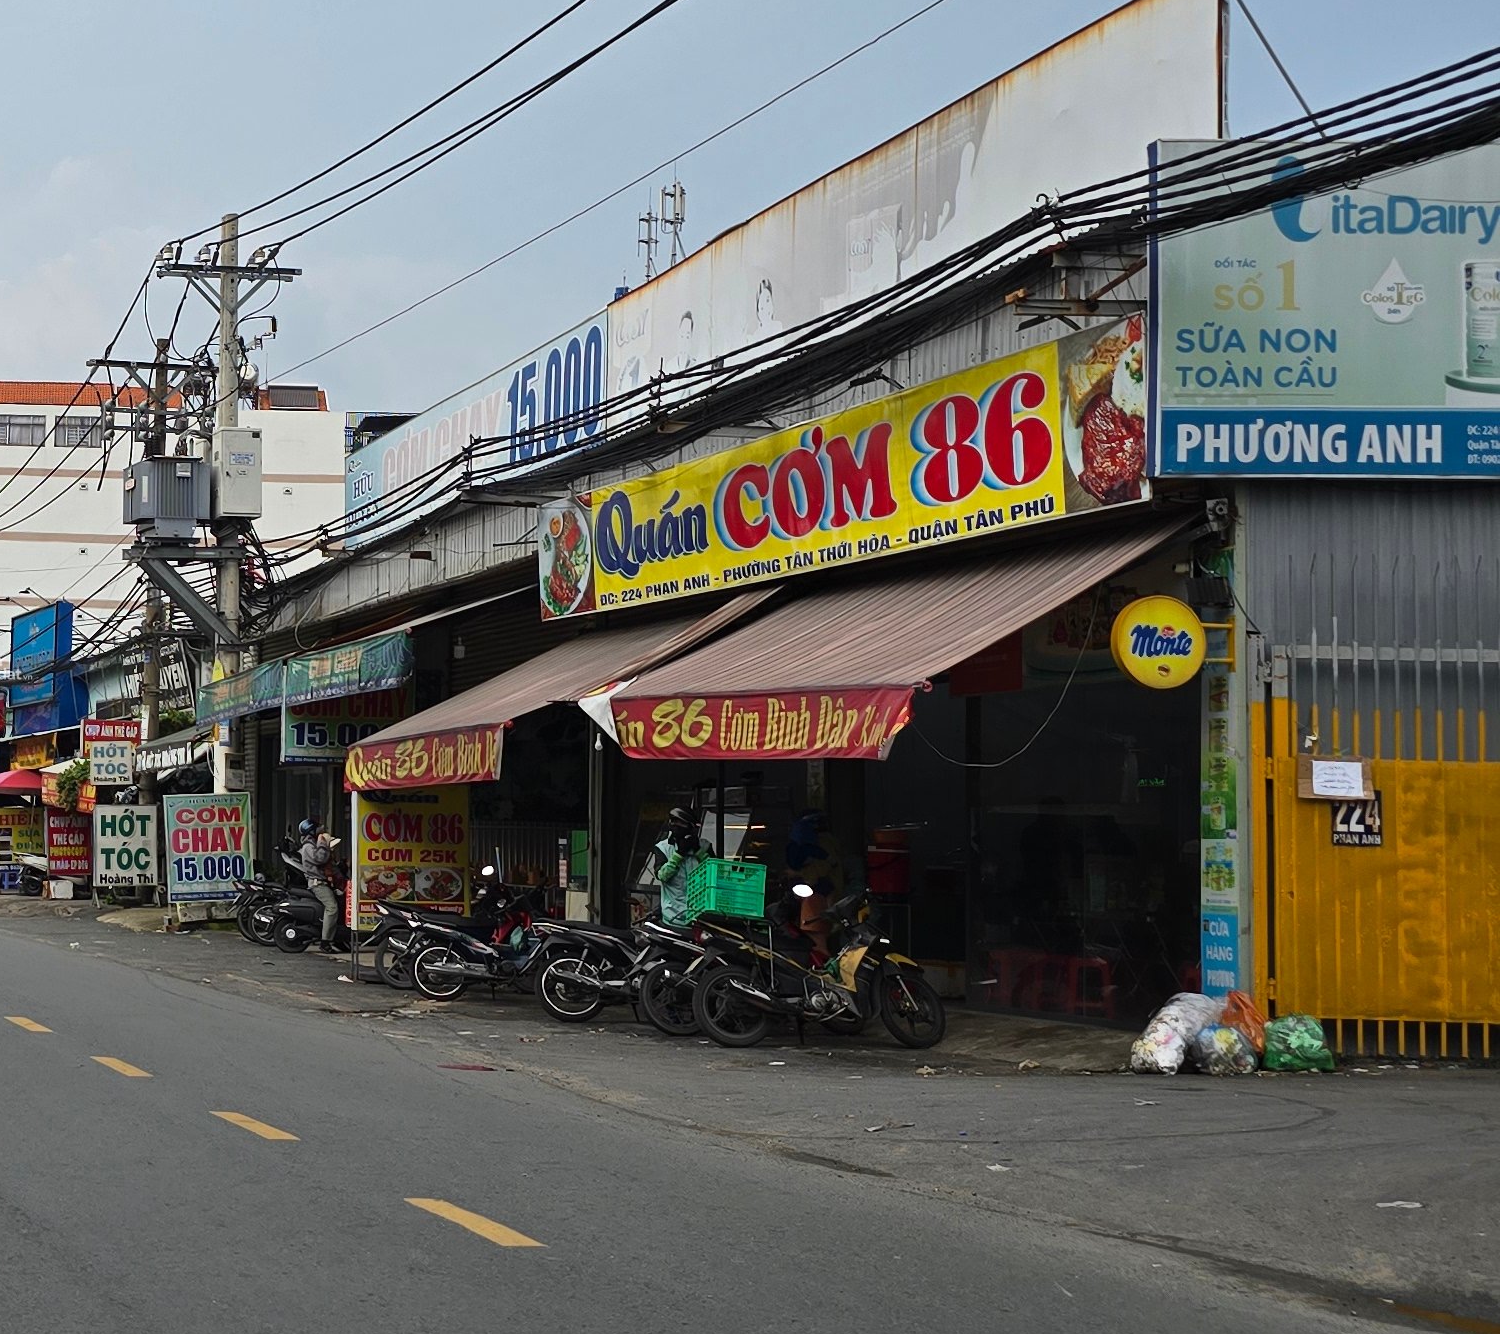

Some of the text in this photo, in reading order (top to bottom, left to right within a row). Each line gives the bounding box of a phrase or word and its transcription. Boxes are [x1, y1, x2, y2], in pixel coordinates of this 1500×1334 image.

[1275, 259, 1301, 311] 1
[1176, 321, 1338, 354] SỮA NON
[1176, 356, 1338, 389] TOÀN CẦU
[1176, 418, 1443, 465] PHƯƠNG ANH
[595, 371, 1053, 580] Quán CƠM 86
[621, 589, 643, 603] 224
[645, 580, 679, 598] PHAN
[683, 573, 710, 592] ANH
[723, 558, 781, 583] PHƯỜNG
[785, 551, 814, 571] TÂN
[817, 542, 852, 563] THỚI
[908, 518, 958, 545] QUẬN
[964, 508, 1004, 532] TÂN
[1010, 493, 1055, 522] PHÚ
[1129, 624, 1194, 658] Monte
[616, 710, 646, 749] án
[651, 698, 713, 748] 86
[719, 699, 759, 751] Cơm
[763, 696, 808, 751] Bình
[813, 695, 858, 749] Dân
[93, 742, 128, 758] HỚT
[345, 746, 392, 788] Quán
[395, 738, 429, 779] 86
[432, 737, 454, 778] Cơm
[457, 732, 483, 775] Bình
[93, 759, 128, 775] TÓC
[100, 808, 152, 838] HỚT
[174, 804, 242, 825] CƠM
[362, 808, 465, 845] CƠM 86
[1333, 799, 1381, 833] 224
[171, 826, 246, 854] CHAY
[367, 847, 458, 864] CƠM 25K
[1333, 833, 1382, 845] PHAN ANH
[100, 841, 152, 871] TÓC
[172, 854, 247, 882] 15.000
[99, 873, 134, 886] Hoàng
